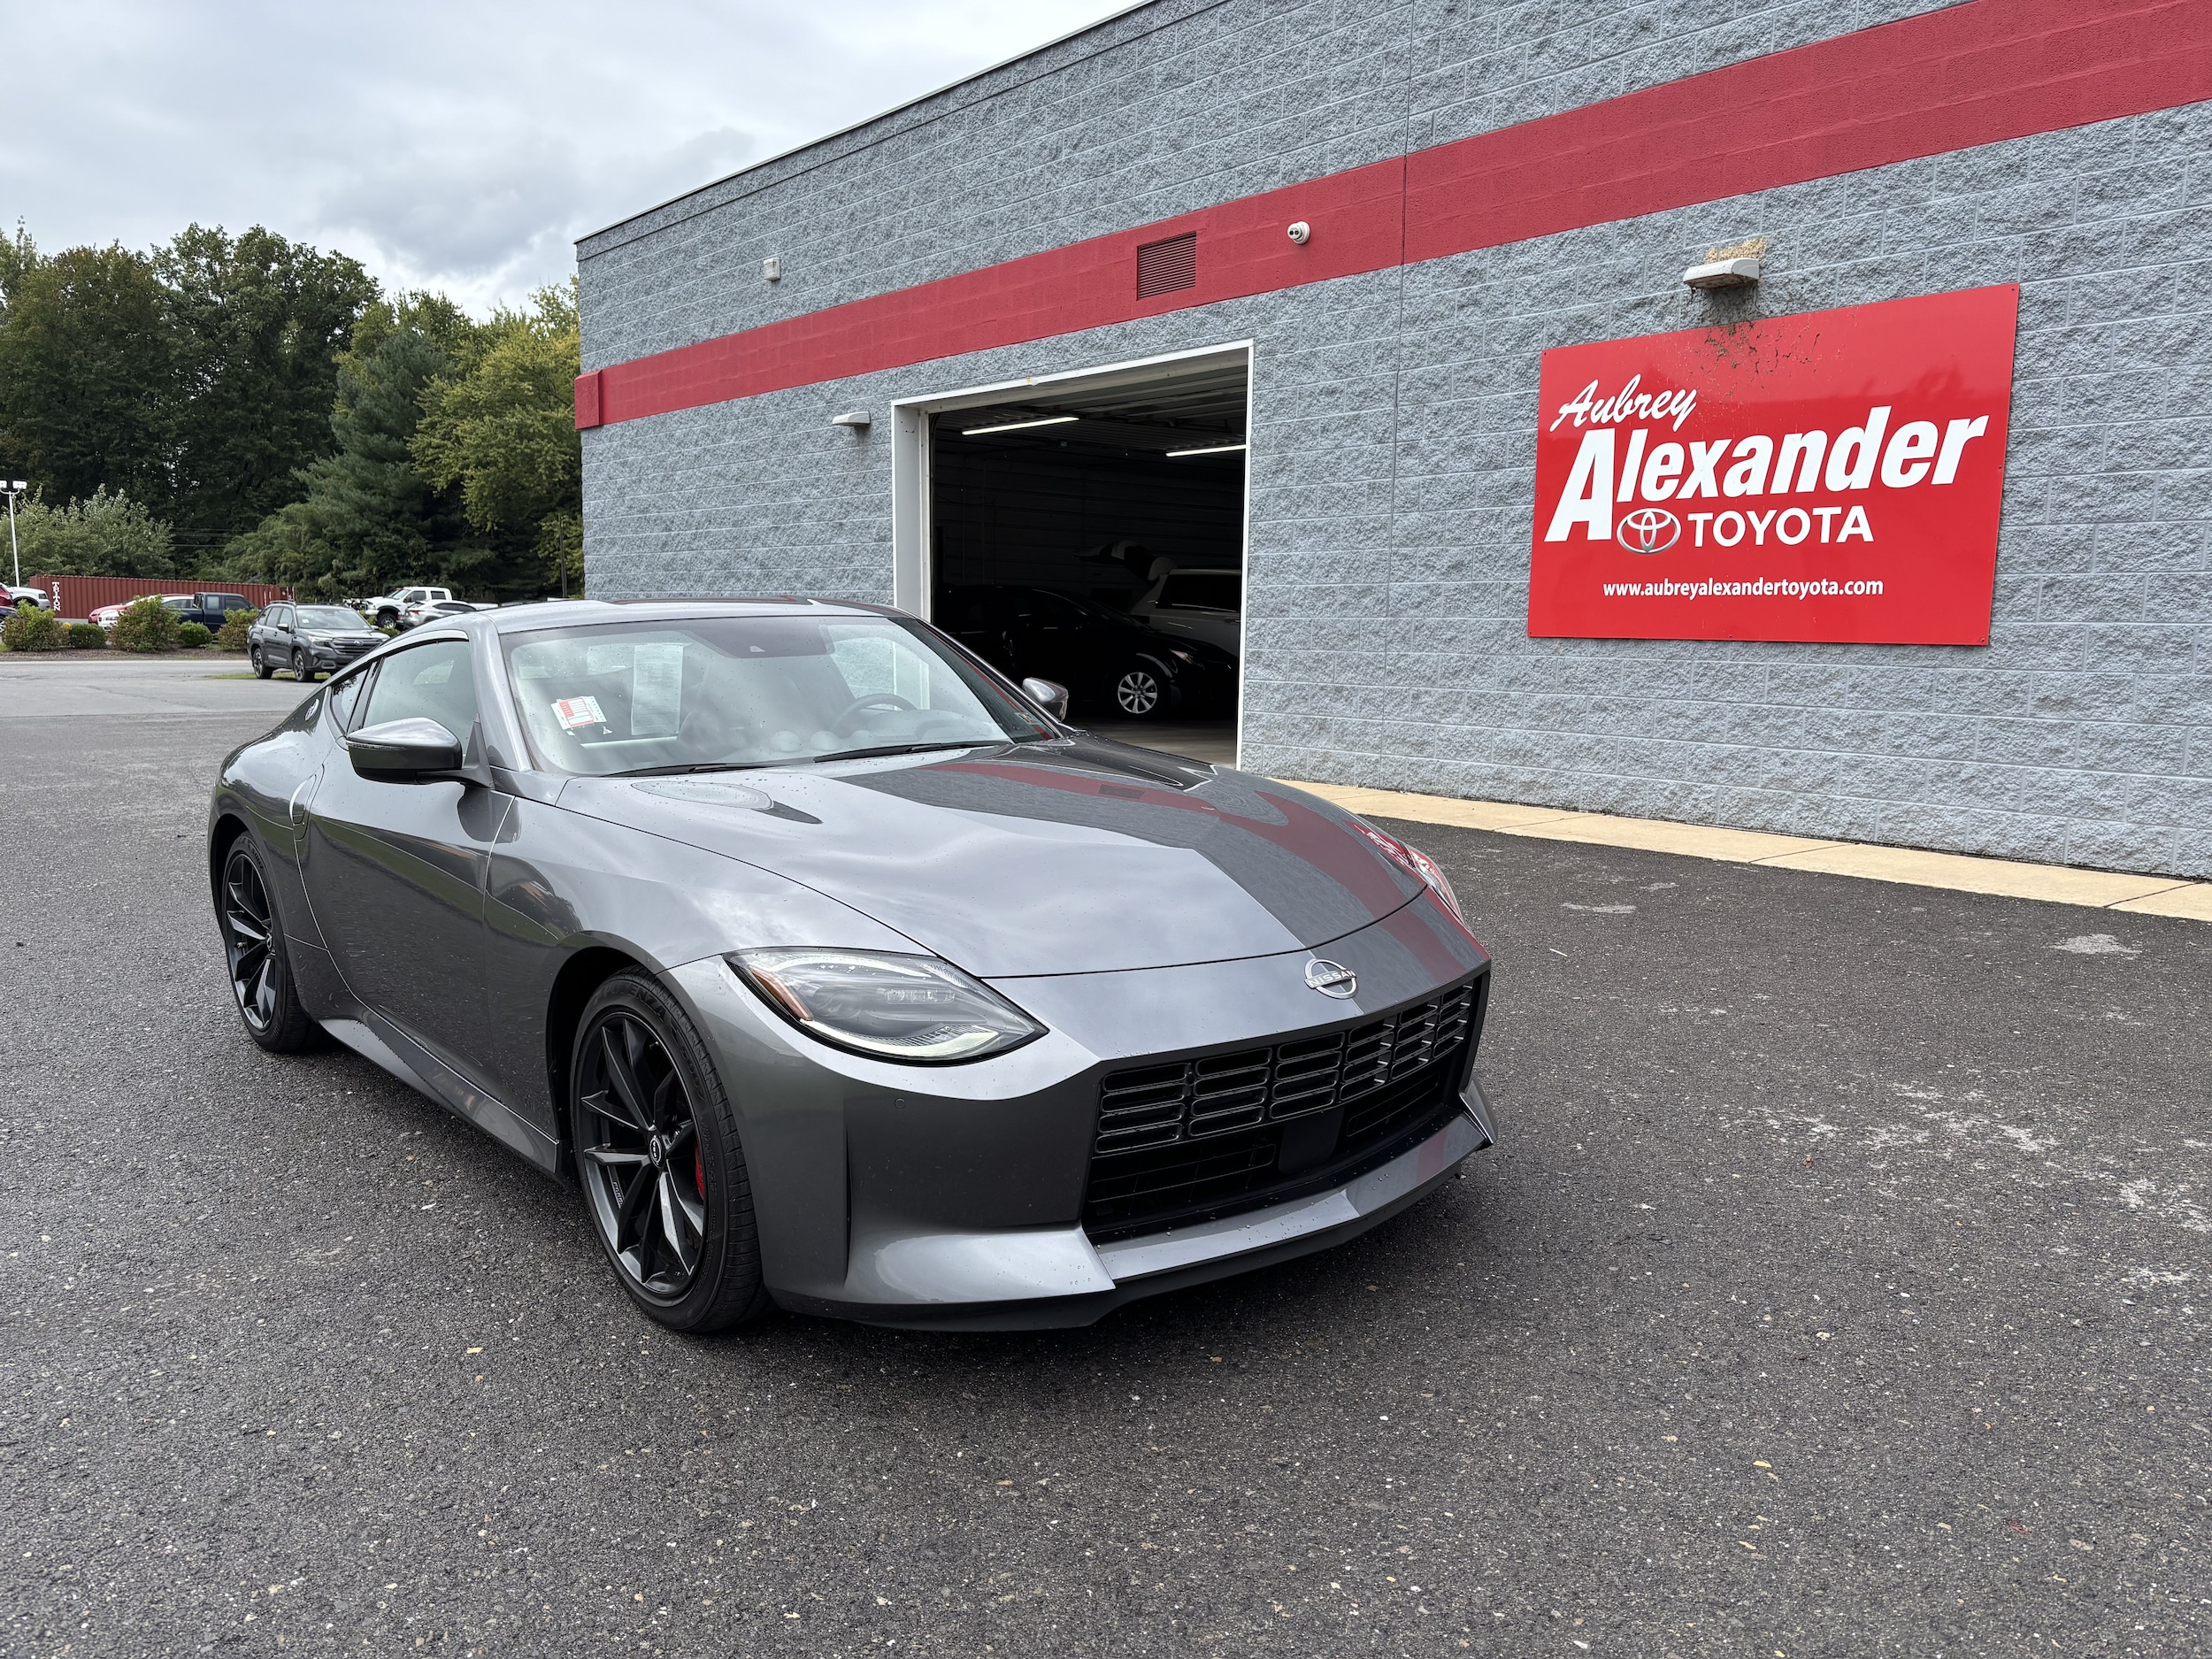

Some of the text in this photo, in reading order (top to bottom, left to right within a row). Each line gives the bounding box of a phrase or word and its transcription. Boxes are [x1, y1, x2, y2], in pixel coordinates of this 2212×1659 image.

[1550, 373, 1697, 433] Aubrey
[1544, 405, 1990, 542] Alexander
[1687, 505, 1874, 548] TOYOTA
[51, 581, 61, 611] TRITON
[1602, 576, 1885, 601] www.aubreyalexandertoyota.com
[1307, 969, 1356, 987] NISSAN
